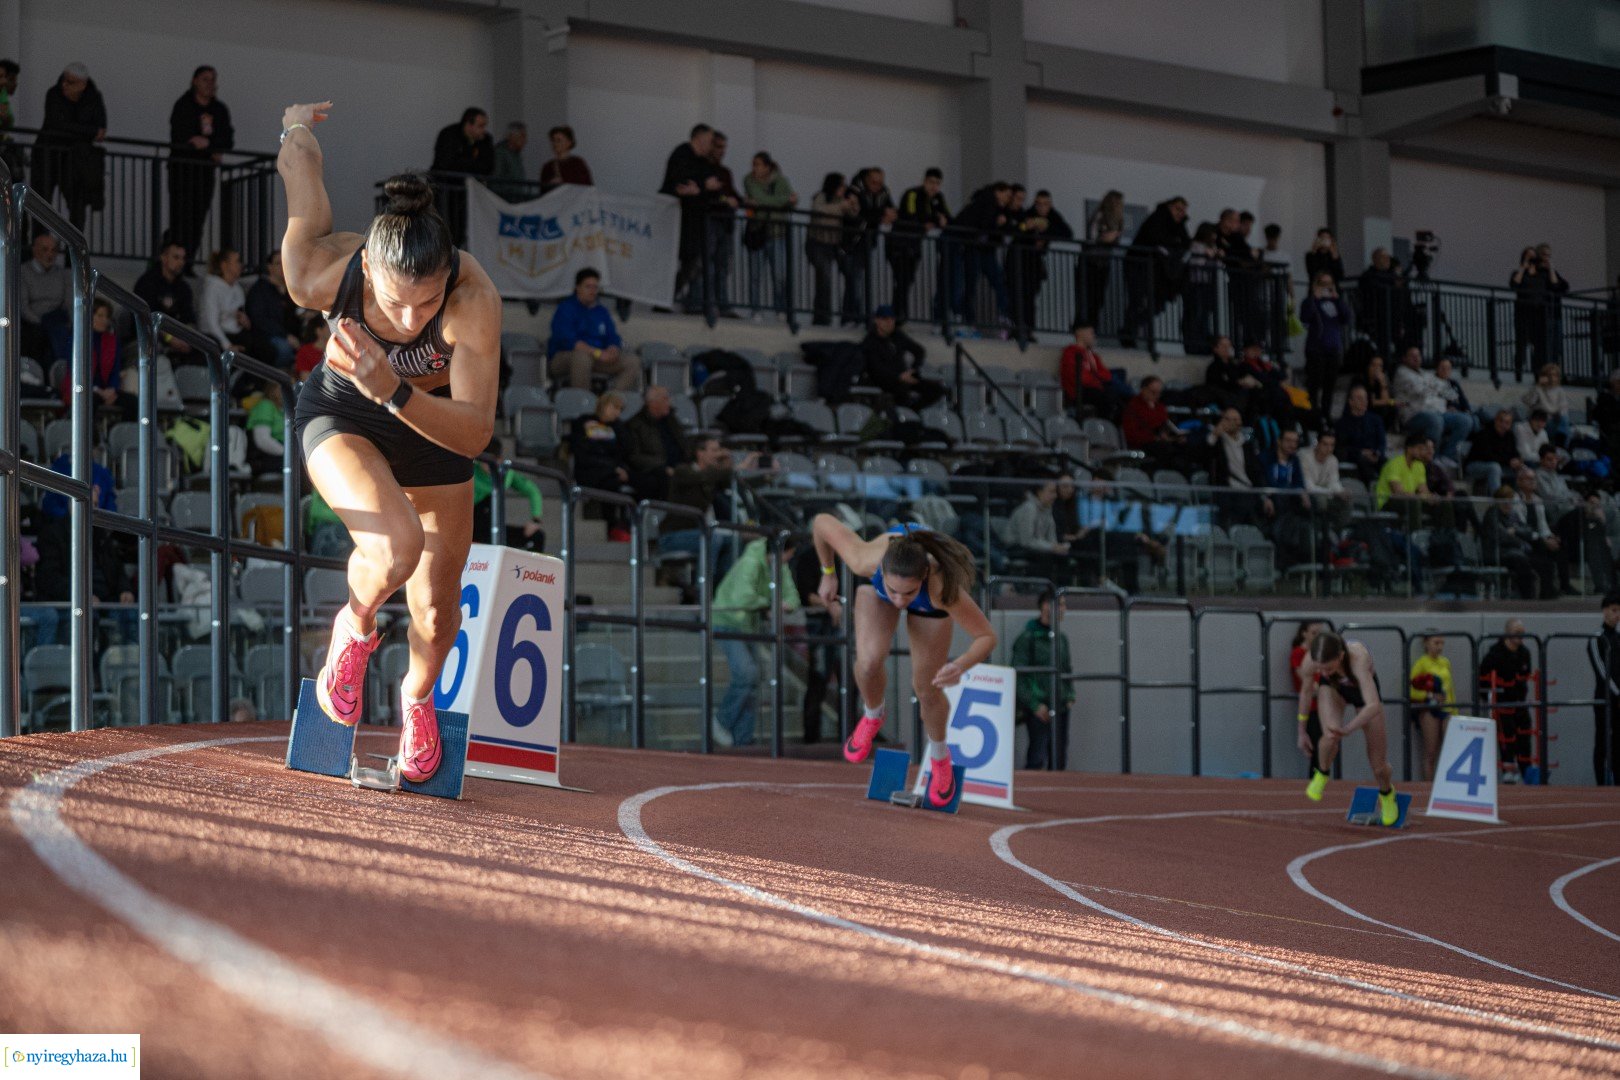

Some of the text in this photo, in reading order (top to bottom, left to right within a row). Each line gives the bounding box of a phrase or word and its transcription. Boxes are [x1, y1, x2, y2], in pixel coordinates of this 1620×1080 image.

[522, 569, 556, 585] polanik
[433, 583, 480, 711] 6
[494, 593, 552, 728] 6
[946, 687, 1003, 770] 5
[1445, 737, 1487, 796] 4
